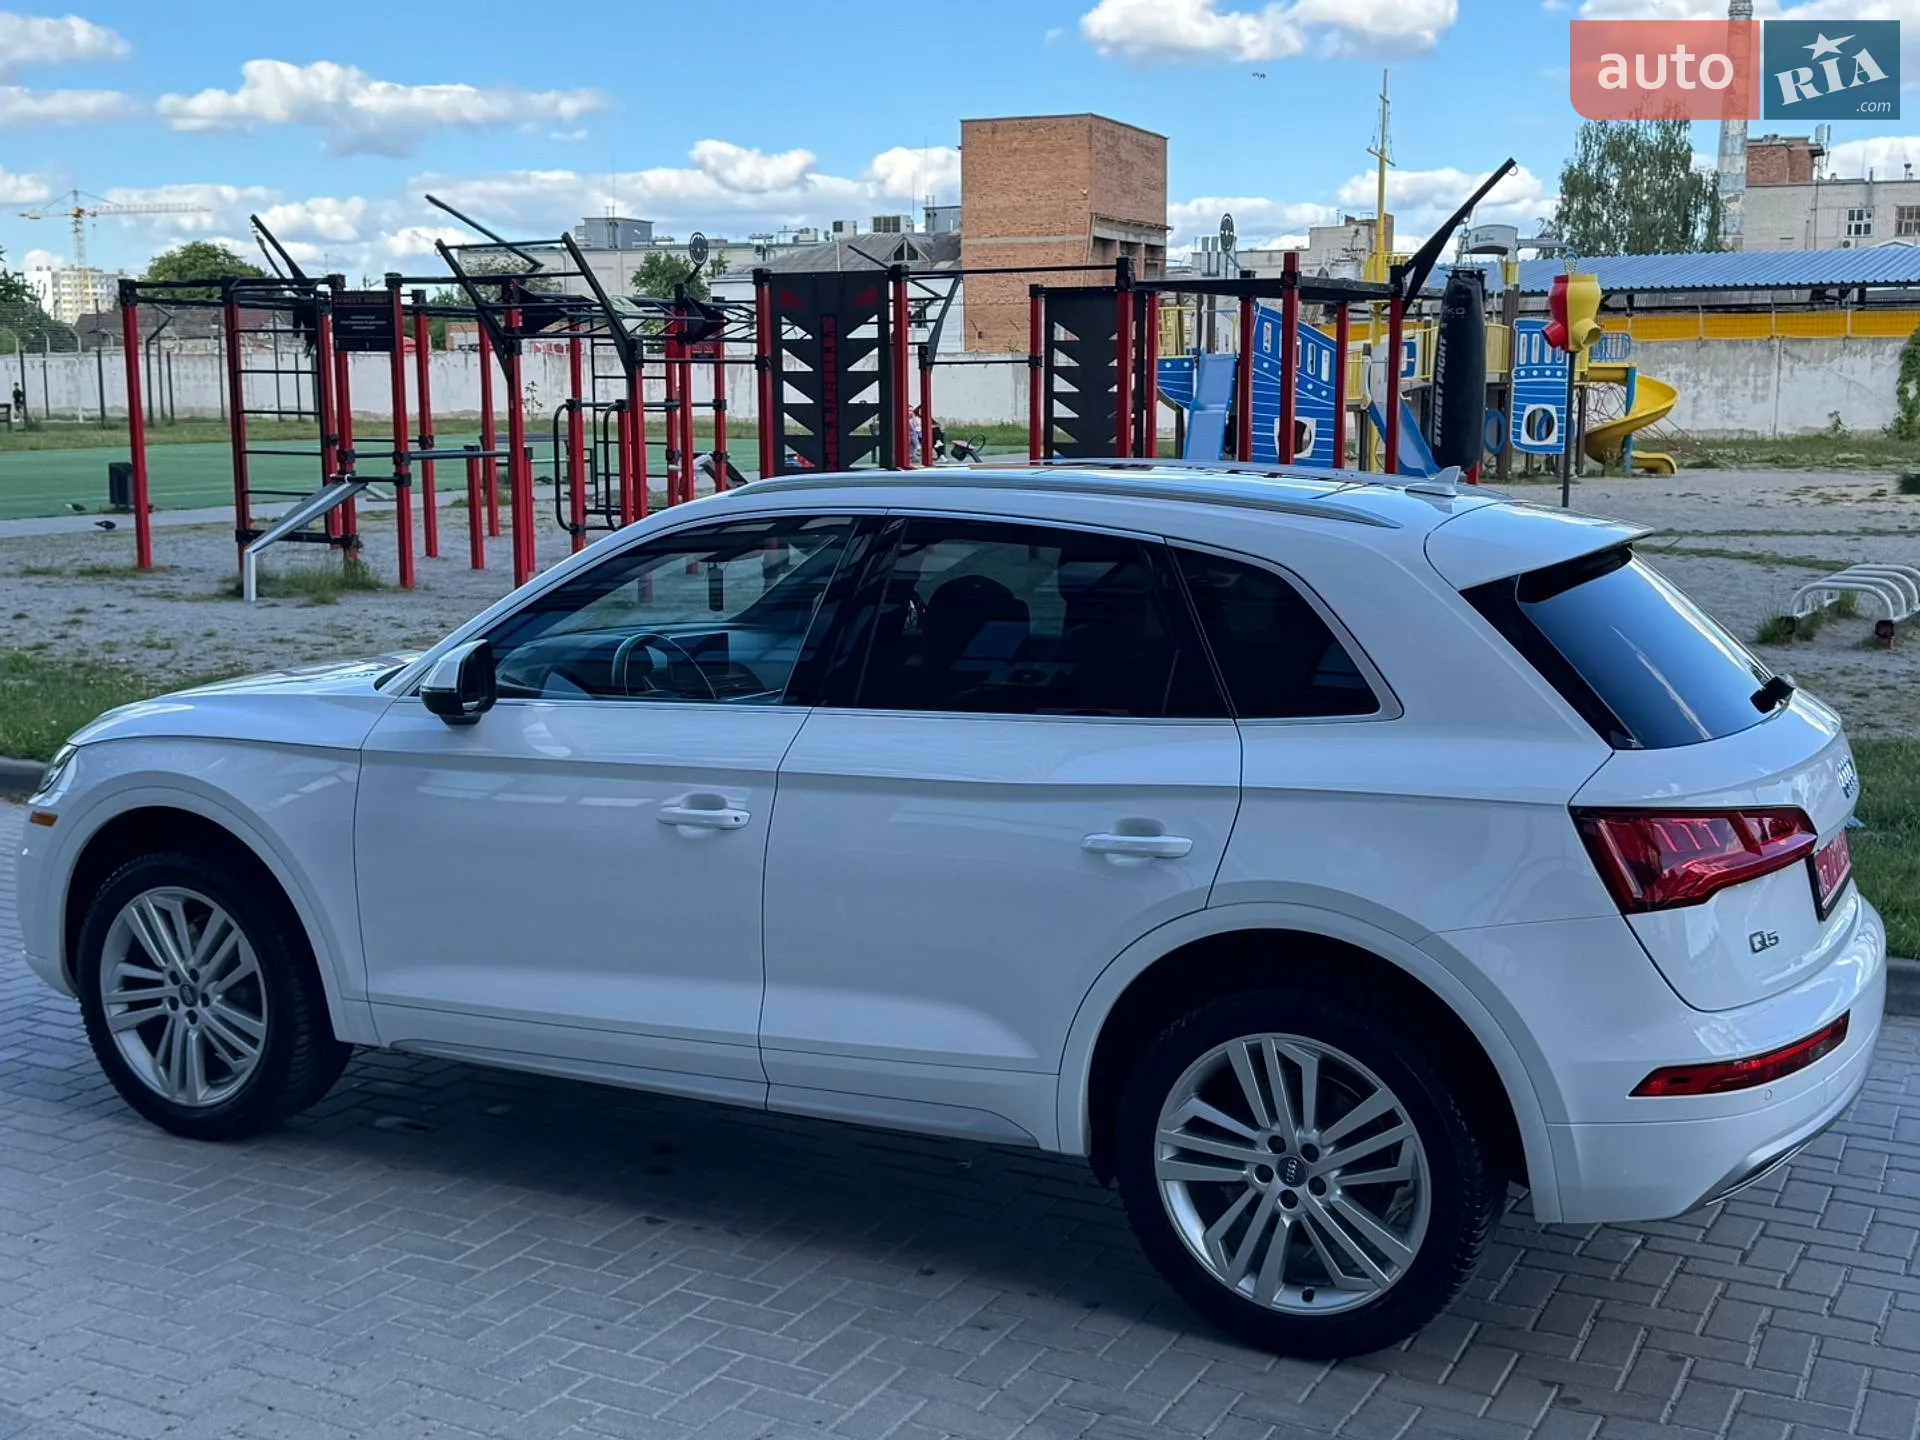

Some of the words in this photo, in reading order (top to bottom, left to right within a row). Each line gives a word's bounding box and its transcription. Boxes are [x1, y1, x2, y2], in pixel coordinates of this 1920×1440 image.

[1436, 335, 1447, 384] FIGHT
[1433, 384, 1444, 447] STREET
[1749, 931, 1779, 954] Q5
